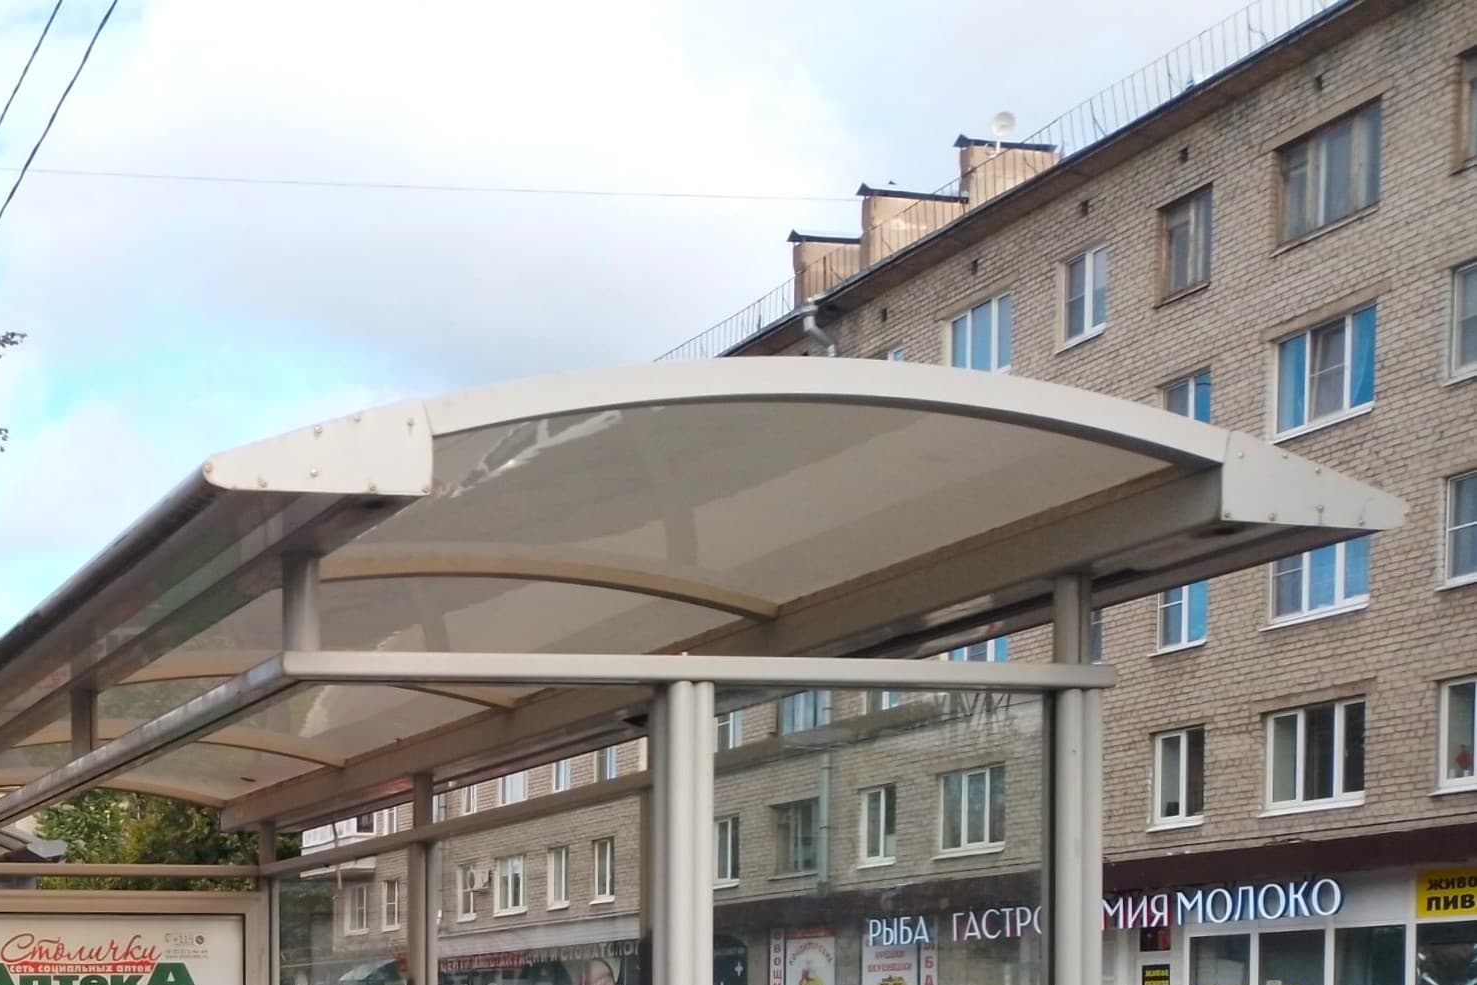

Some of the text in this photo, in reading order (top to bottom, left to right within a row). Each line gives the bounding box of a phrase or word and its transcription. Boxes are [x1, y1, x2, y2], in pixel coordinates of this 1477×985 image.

[868, 915, 930, 947] РЫБА
[1176, 878, 1342, 926] МОЛОКО
[0, 933, 163, 963] Столички
[560, 941, 640, 960] СТОМАТОЛОГ
[9, 963, 152, 975] сеть социальных аптек
